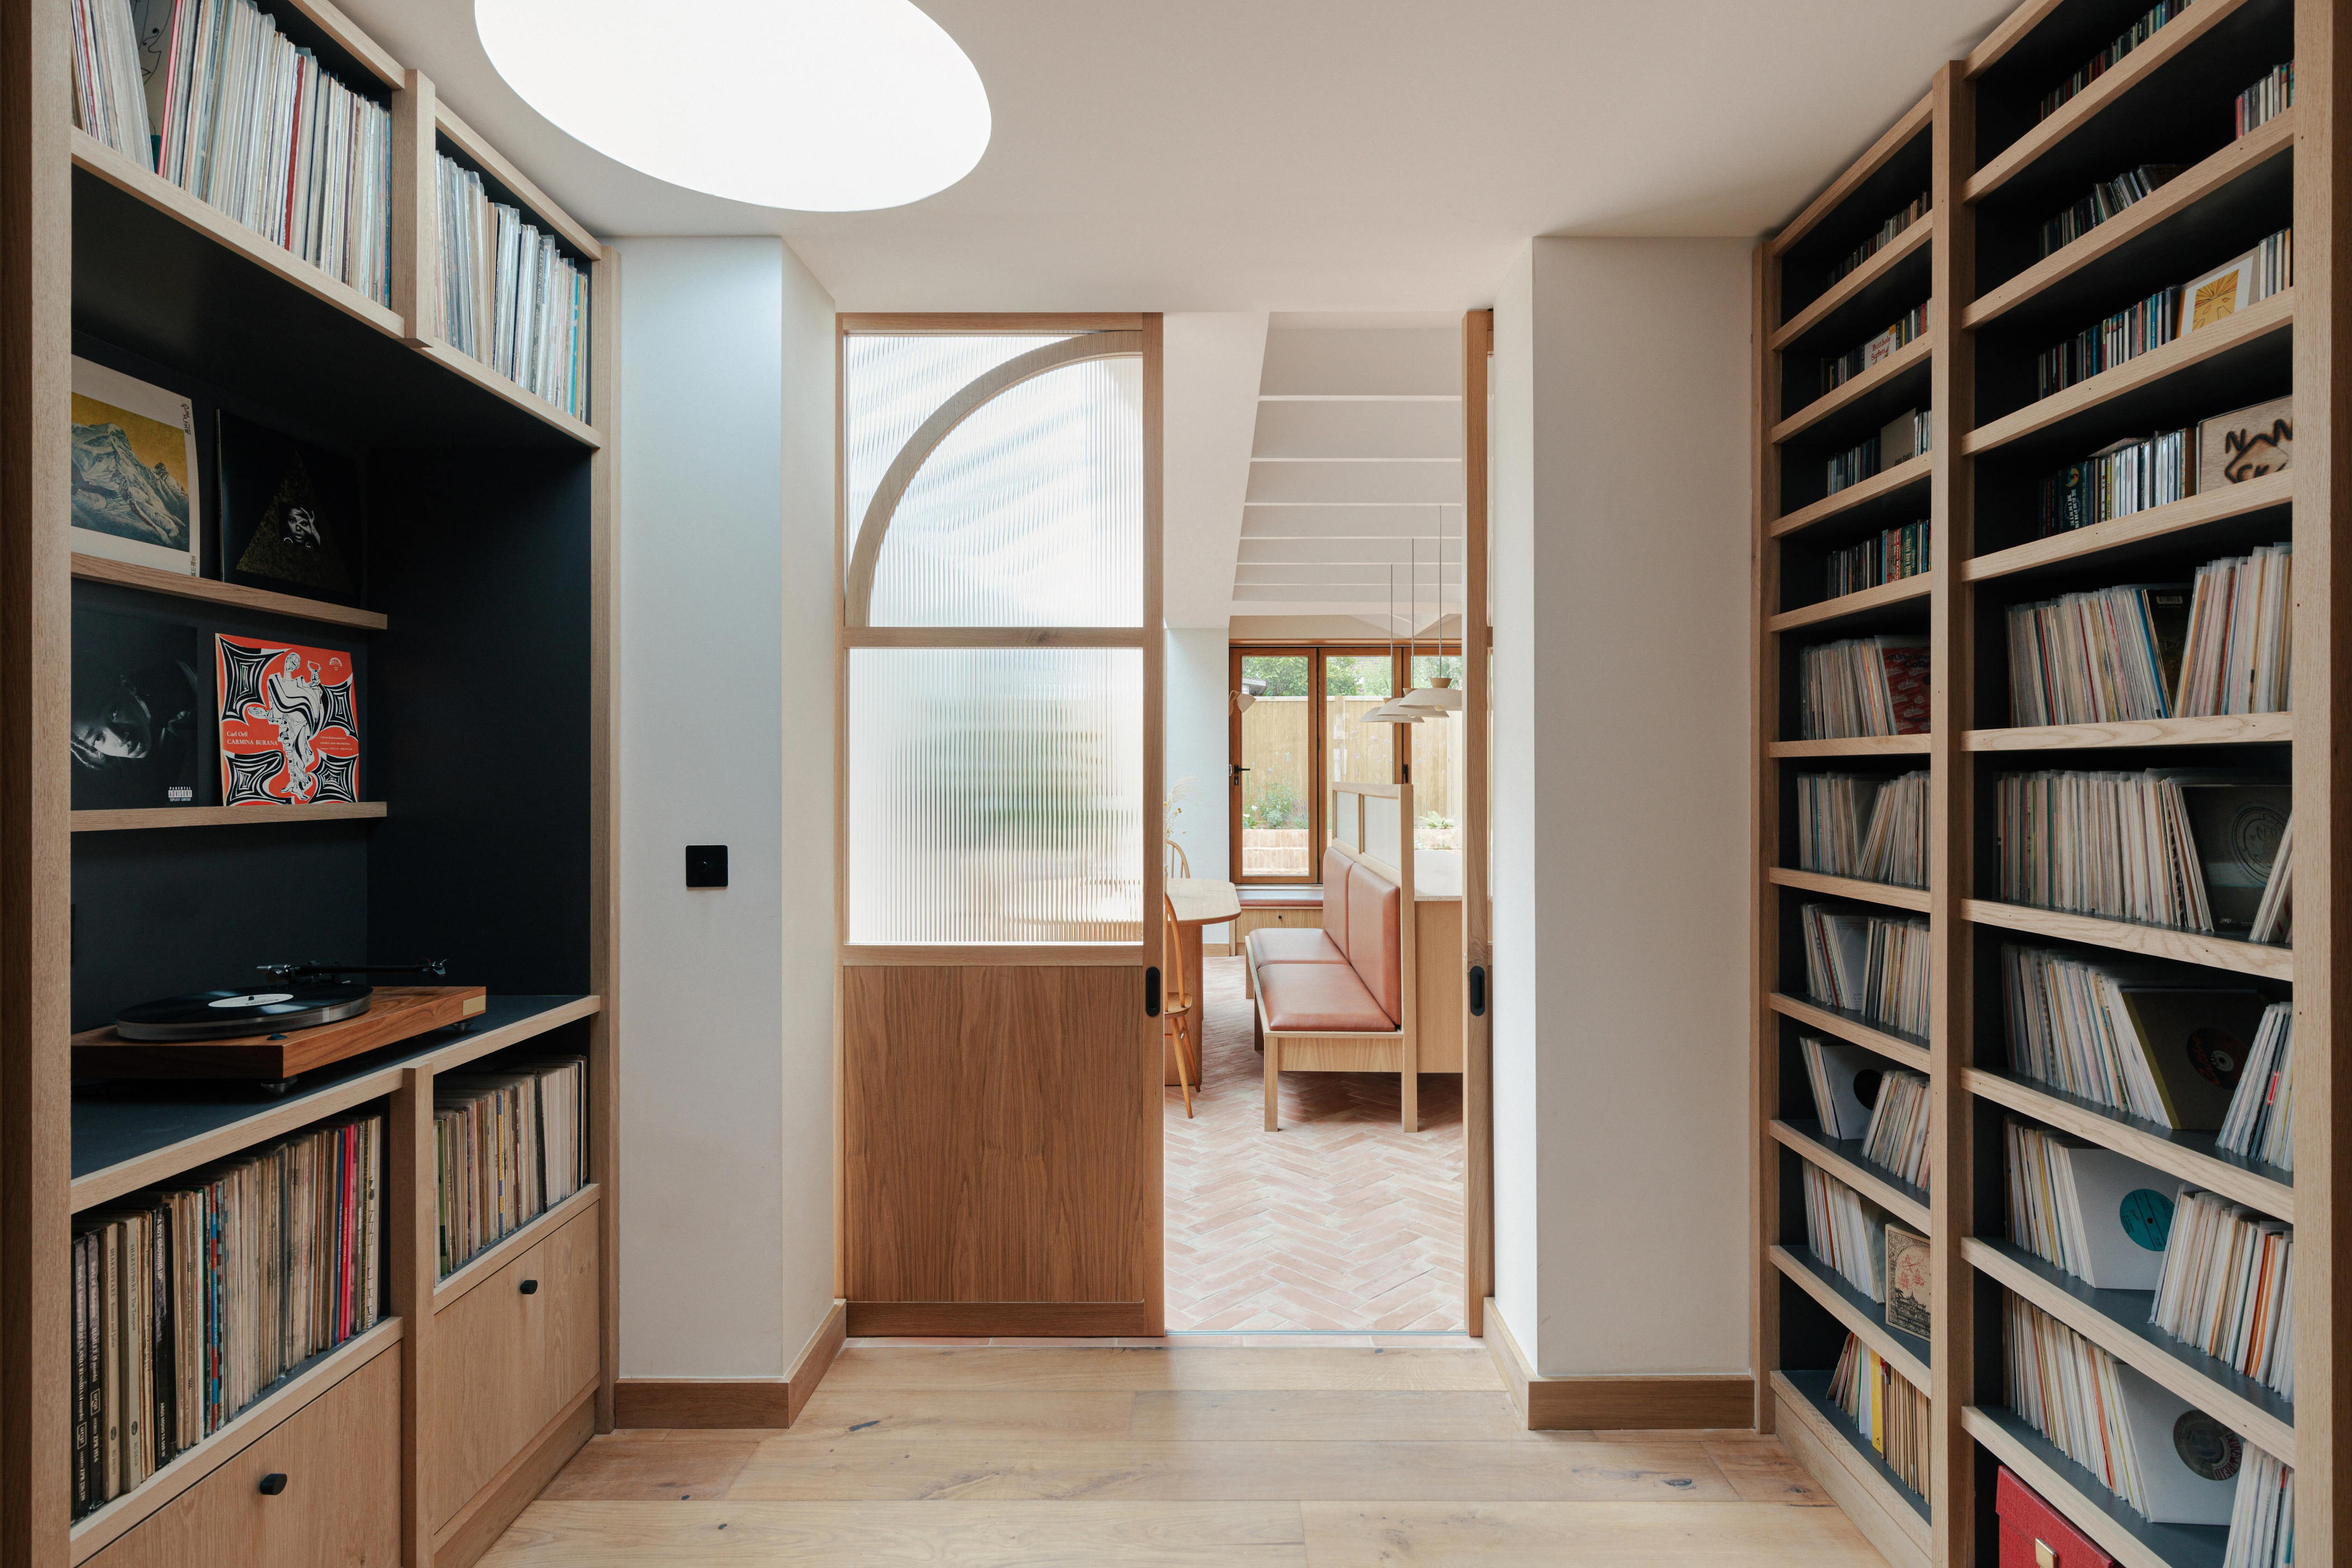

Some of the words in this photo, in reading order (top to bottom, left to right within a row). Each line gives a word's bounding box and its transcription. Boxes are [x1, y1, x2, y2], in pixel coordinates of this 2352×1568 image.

[1871, 347, 1886, 361] Surfers
[1872, 336, 1891, 351] Butthole
[2066, 494, 2075, 527] MINNIE
[2071, 489, 2080, 529] MEMPHIS
[77, 1265, 86, 1282] Works
[77, 1291, 86, 1321] Shakespeare
[78, 1322, 87, 1348] TROILUS
[78, 1350, 87, 1363] AND
